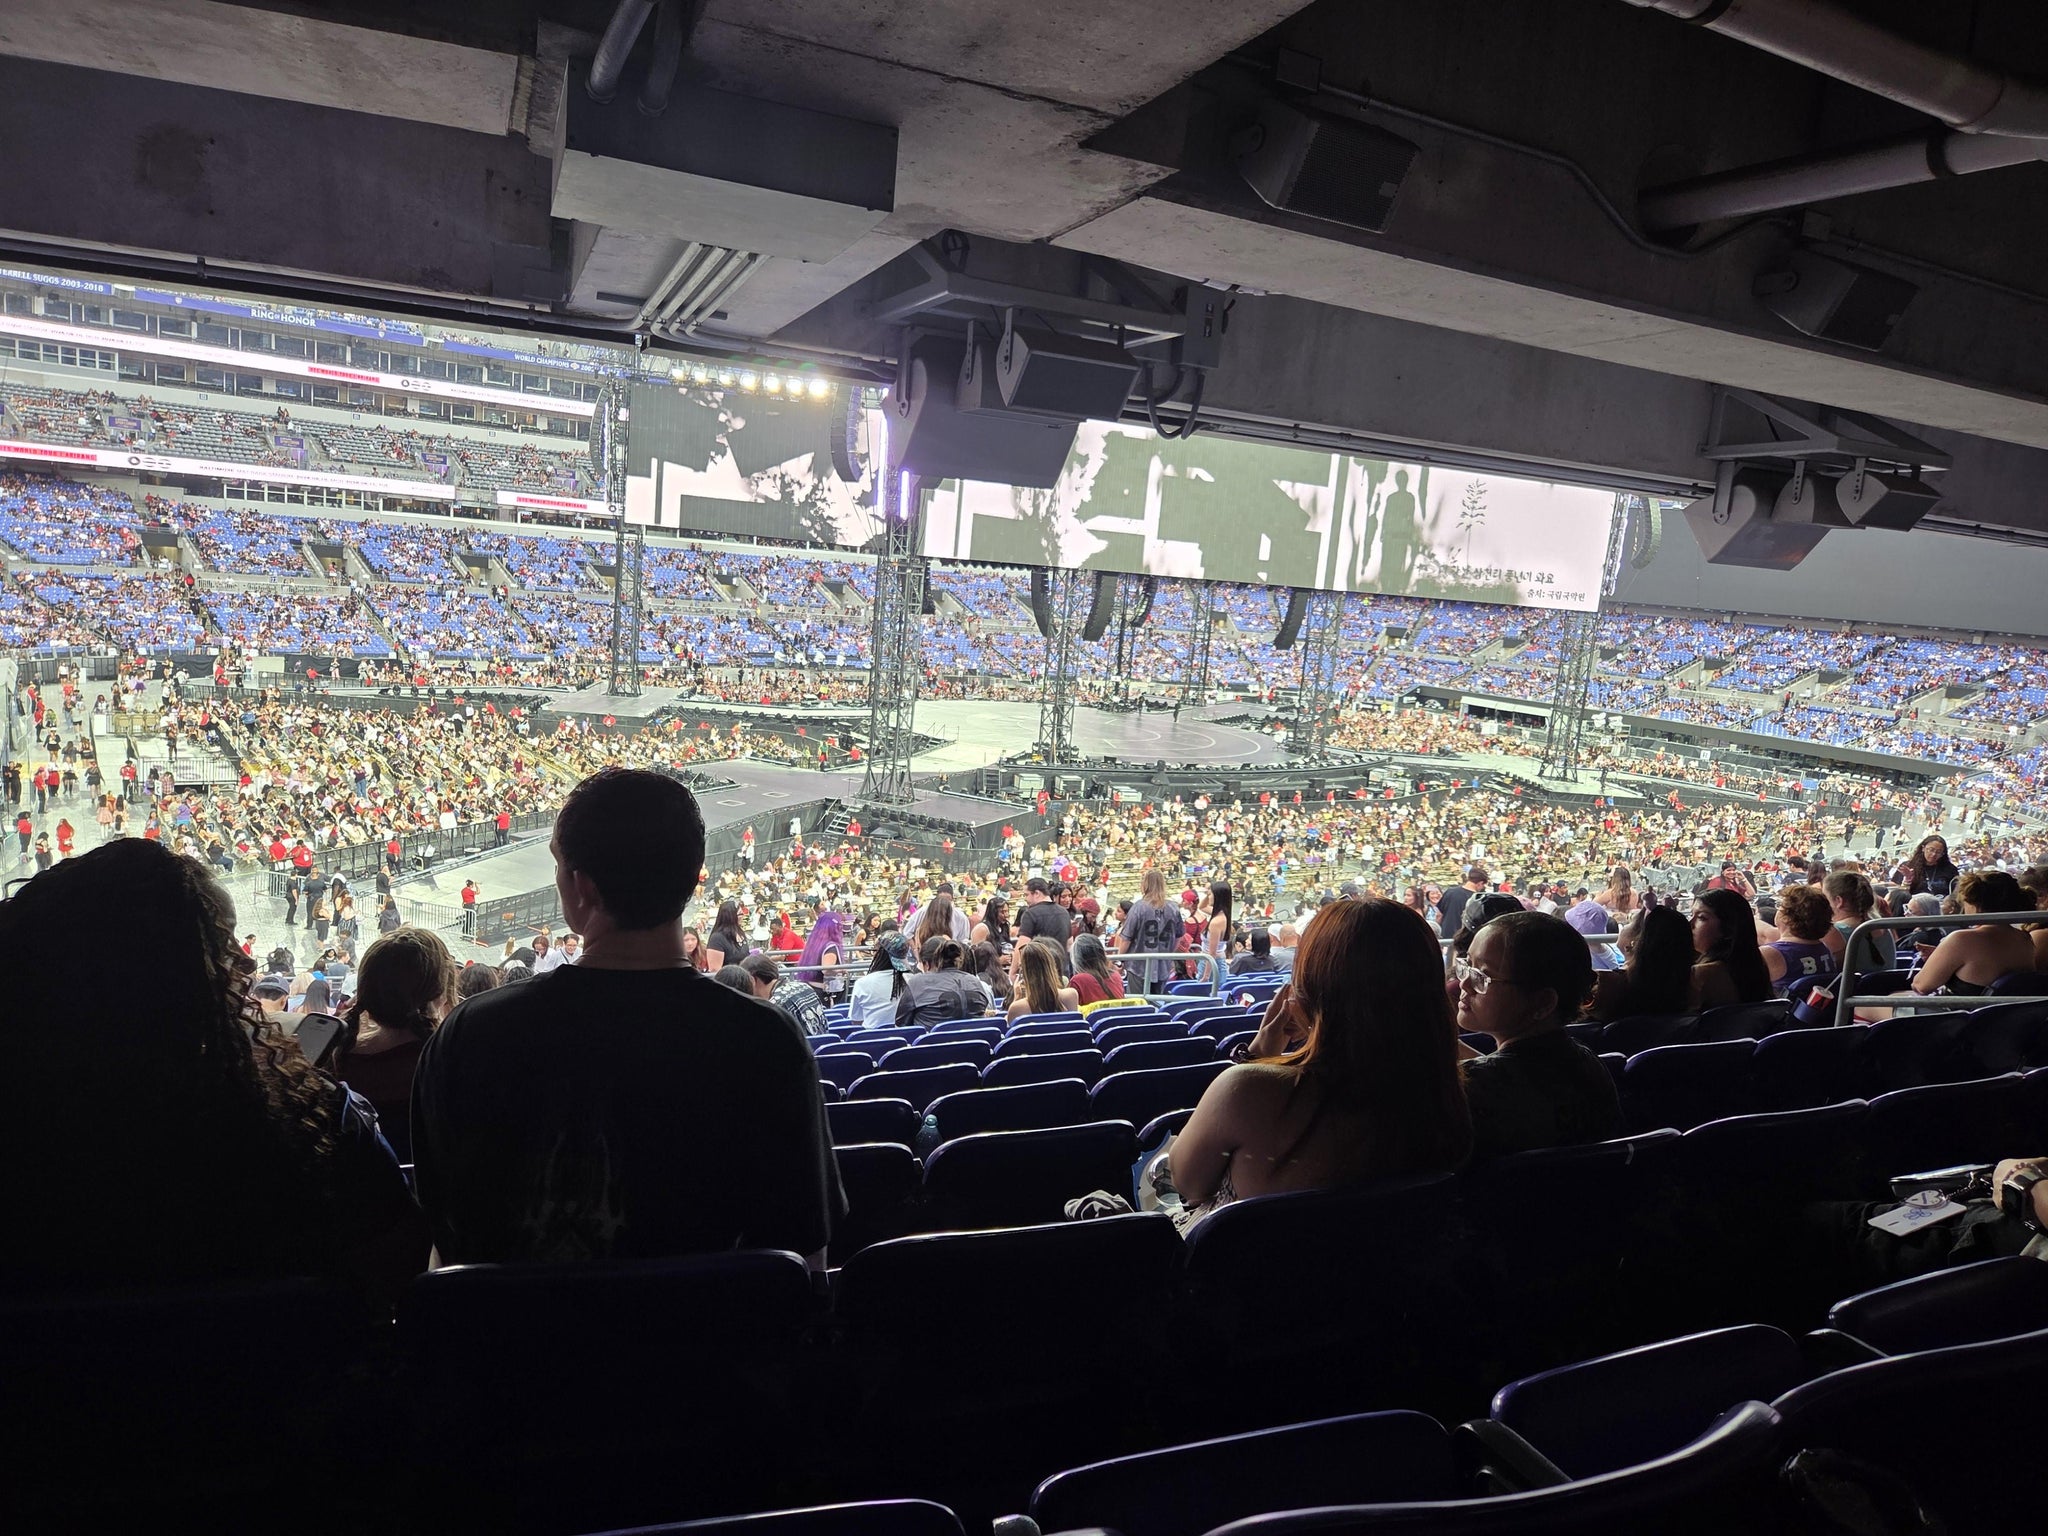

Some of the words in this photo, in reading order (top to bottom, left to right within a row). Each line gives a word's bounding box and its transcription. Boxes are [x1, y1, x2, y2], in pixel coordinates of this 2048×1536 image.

[33, 273, 59, 285] SUGGS
[61, 278, 104, 292] 2003-2018
[251, 309, 274, 320] RING
[281, 313, 316, 327] HONOR
[514, 353, 536, 363] WORLD
[536, 357, 570, 369] CHAMPIONS
[1144, 920, 1173, 949] 94
